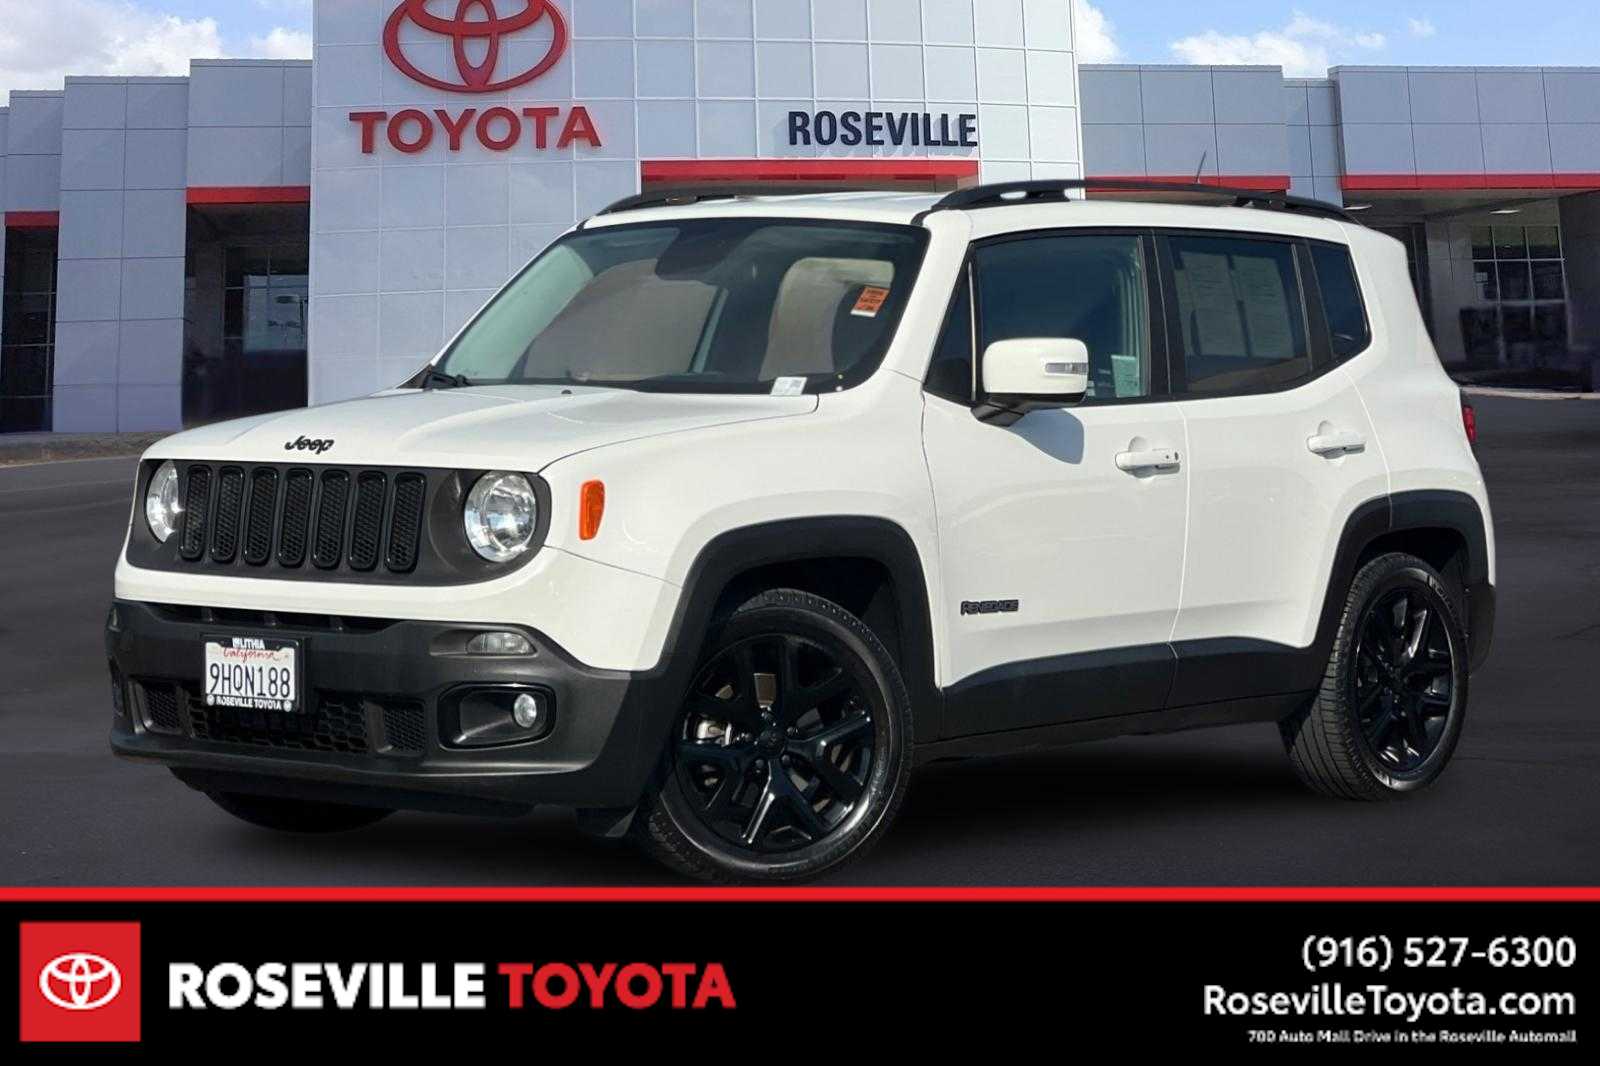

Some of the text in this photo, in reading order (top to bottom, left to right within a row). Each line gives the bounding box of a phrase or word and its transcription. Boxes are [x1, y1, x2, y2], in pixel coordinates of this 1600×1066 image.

[349, 107, 602, 154] TOYOTA
[788, 111, 978, 147] ROSEVILLE
[284, 435, 335, 455] Jeep
[216, 695, 282, 711] ROSEVILLE TOYOTA
